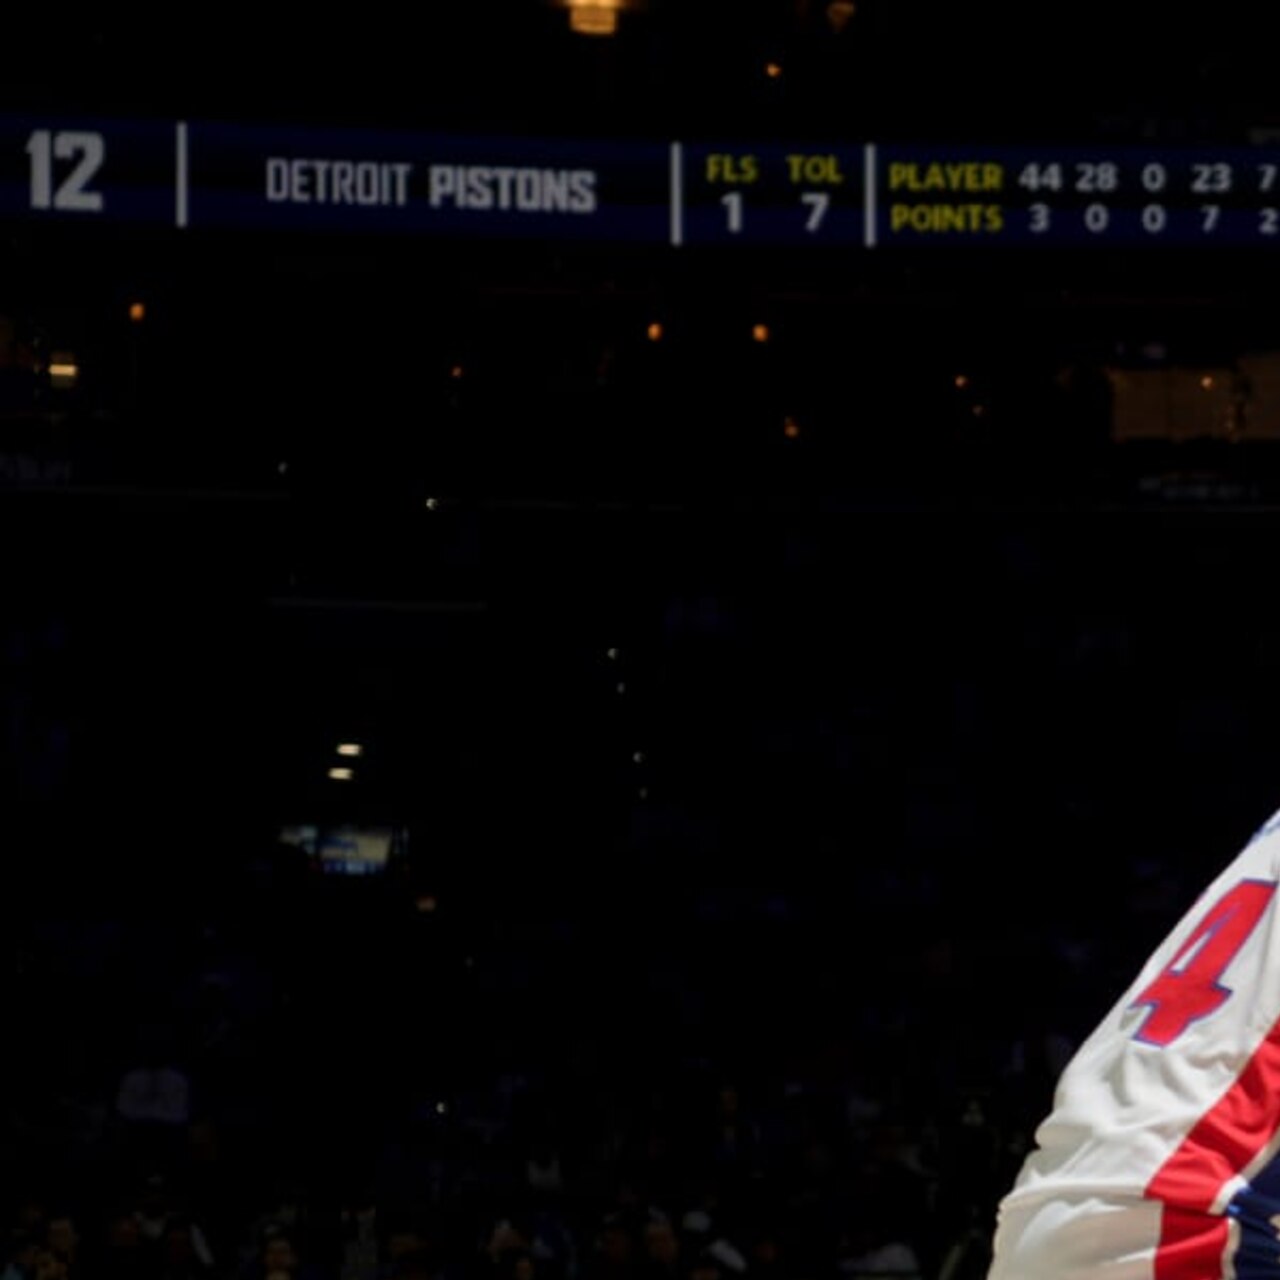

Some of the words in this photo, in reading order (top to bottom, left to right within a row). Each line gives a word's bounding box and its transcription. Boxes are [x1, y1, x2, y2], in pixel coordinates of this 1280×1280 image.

[25, 129, 105, 212] 12
[265, 157, 411, 207] DETROIT
[428, 164, 597, 214] PISTONS
[705, 153, 758, 183] FLS
[786, 154, 843, 184] TOL
[888, 161, 1003, 191] PLAYER
[1017, 162, 1064, 192] 44
[1074, 161, 1118, 193] 28
[1141, 162, 1167, 193] 0
[1190, 162, 1233, 193] 23
[1259, 163, 1278, 191] 7
[720, 191, 743, 234] 1
[800, 191, 830, 232] 7
[890, 203, 1004, 232] POINTS
[1029, 202, 1050, 233] 3
[1083, 202, 1110, 233] 0
[1141, 203, 1167, 234] 0
[1202, 204, 1220, 233] 7
[1258, 206, 1279, 235] 2
[1128, 878, 1280, 1048] 4
